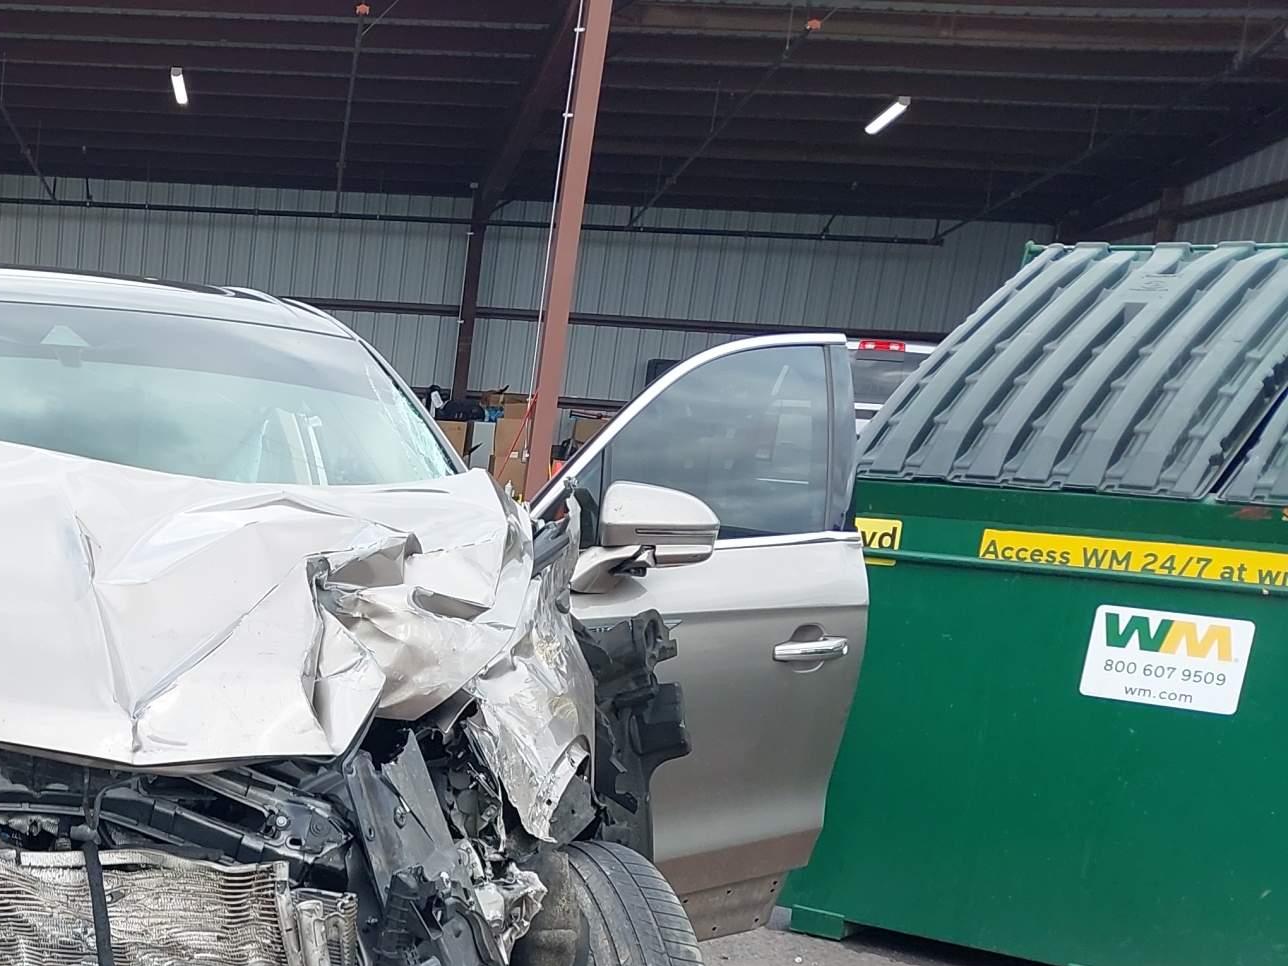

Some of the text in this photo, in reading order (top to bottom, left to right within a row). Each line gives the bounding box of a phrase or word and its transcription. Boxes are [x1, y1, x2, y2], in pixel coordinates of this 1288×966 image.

[981, 539, 1071, 565] Access
[1082, 546, 1133, 572] WM
[1141, 552, 1214, 579] 24/7
[1219, 563, 1248, 582] at
[1104, 612, 1233, 663] WM
[1103, 658, 1227, 687] 800 607 9509
[1123, 685, 1193, 704] wm.com
